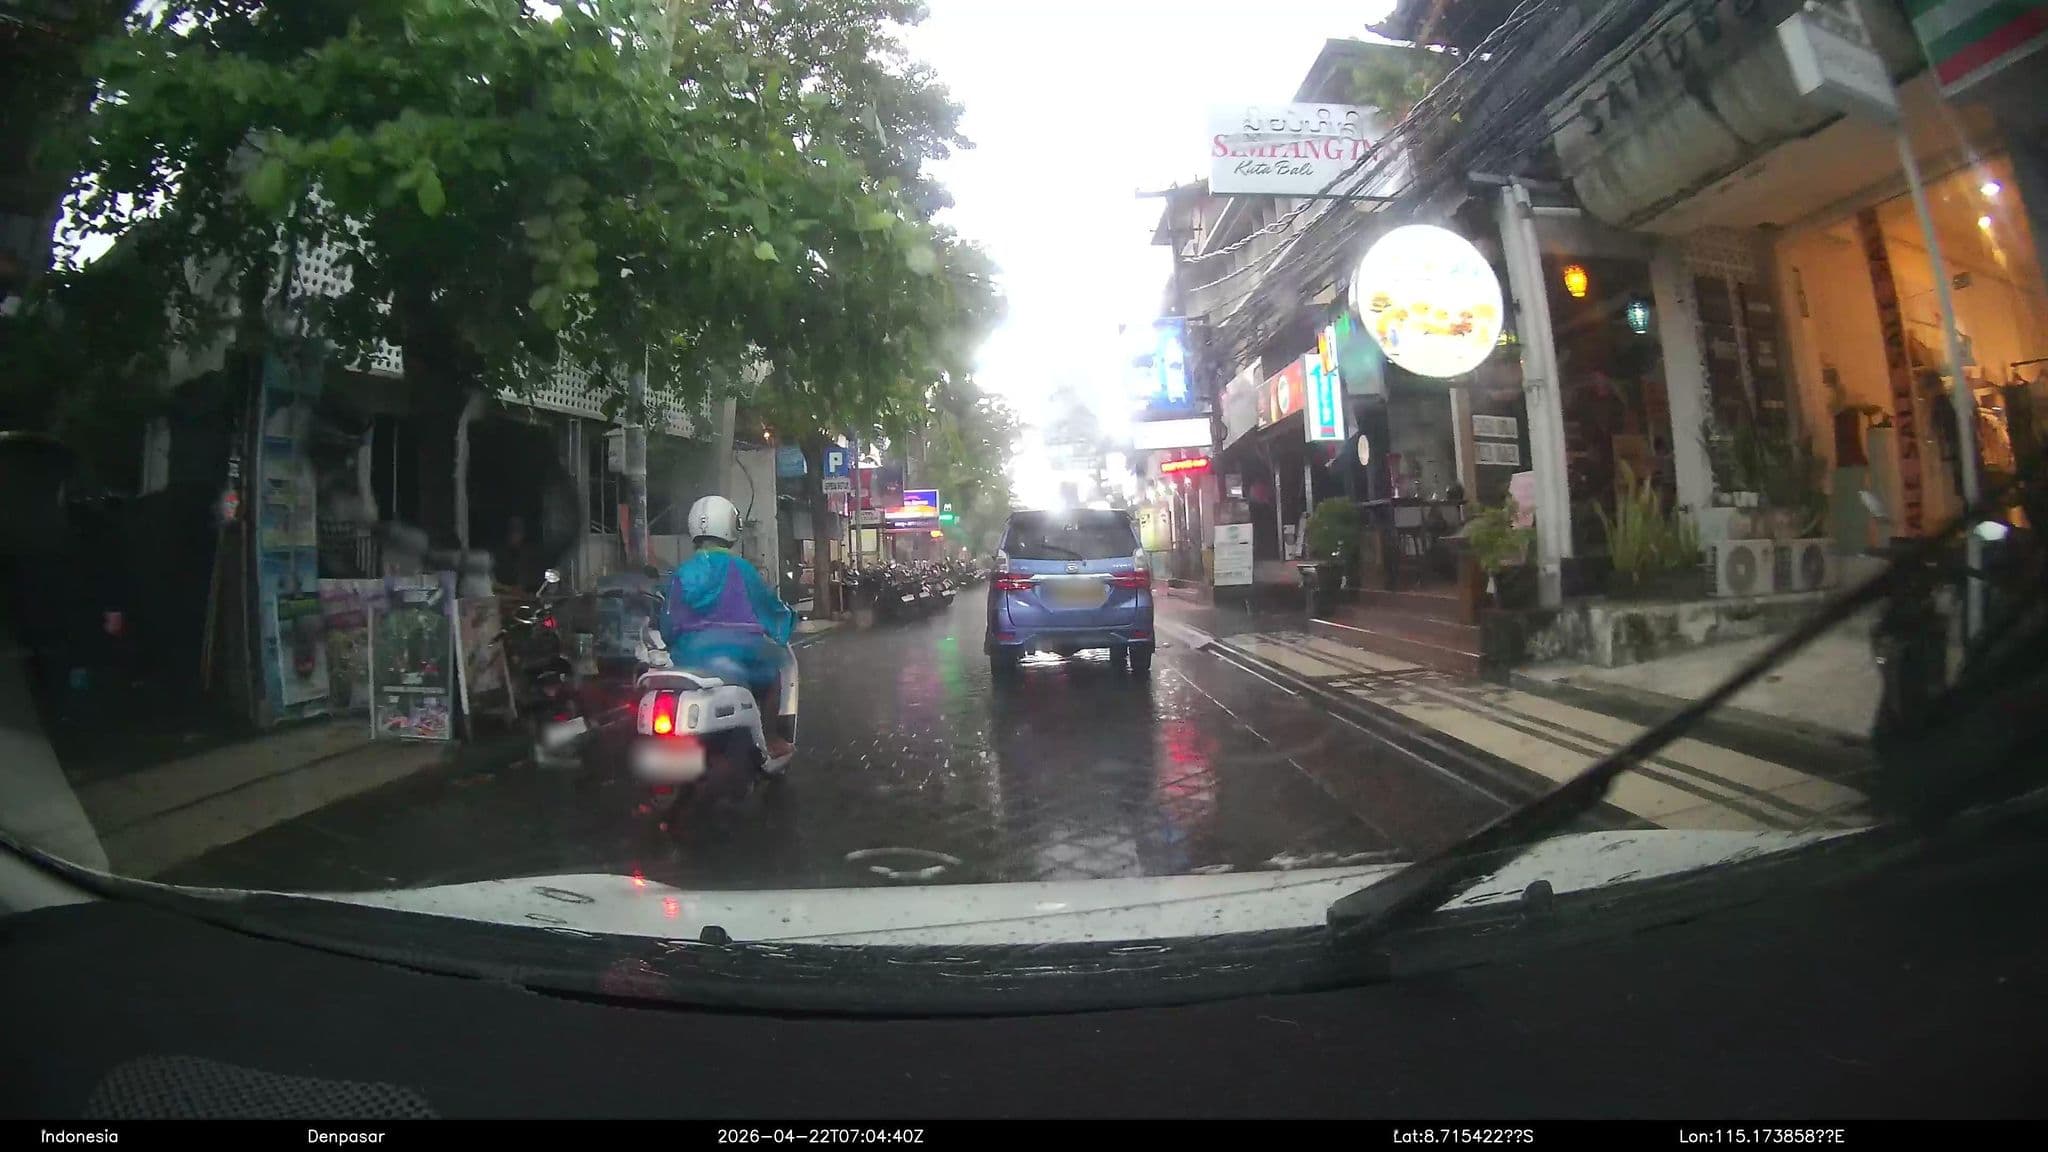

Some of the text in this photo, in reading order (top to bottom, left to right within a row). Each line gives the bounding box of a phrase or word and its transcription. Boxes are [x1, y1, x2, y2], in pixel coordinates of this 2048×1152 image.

[1233, 159, 1314, 176] Kuta Bali
[829, 452, 843, 472] P
